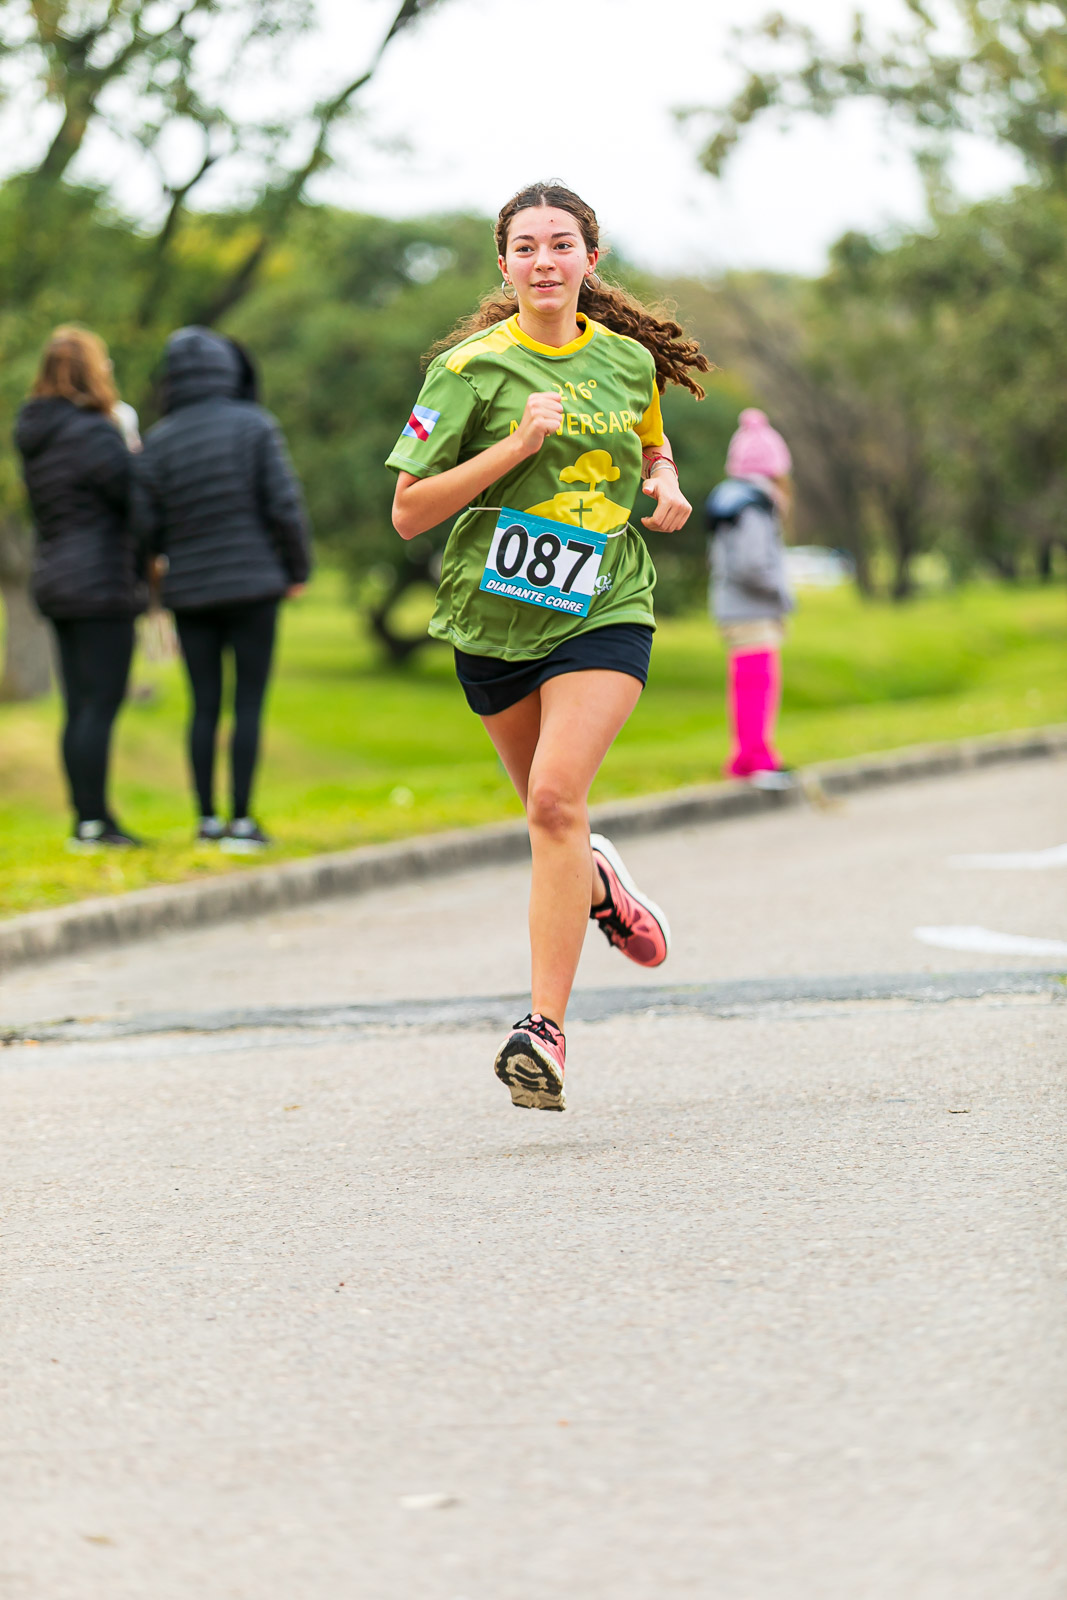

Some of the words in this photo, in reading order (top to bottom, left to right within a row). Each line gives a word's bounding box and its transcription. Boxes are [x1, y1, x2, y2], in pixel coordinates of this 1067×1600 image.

[495, 524, 596, 595] 087
[485, 579, 546, 603] DIAMANTE
[545, 596, 584, 613] CORRE
